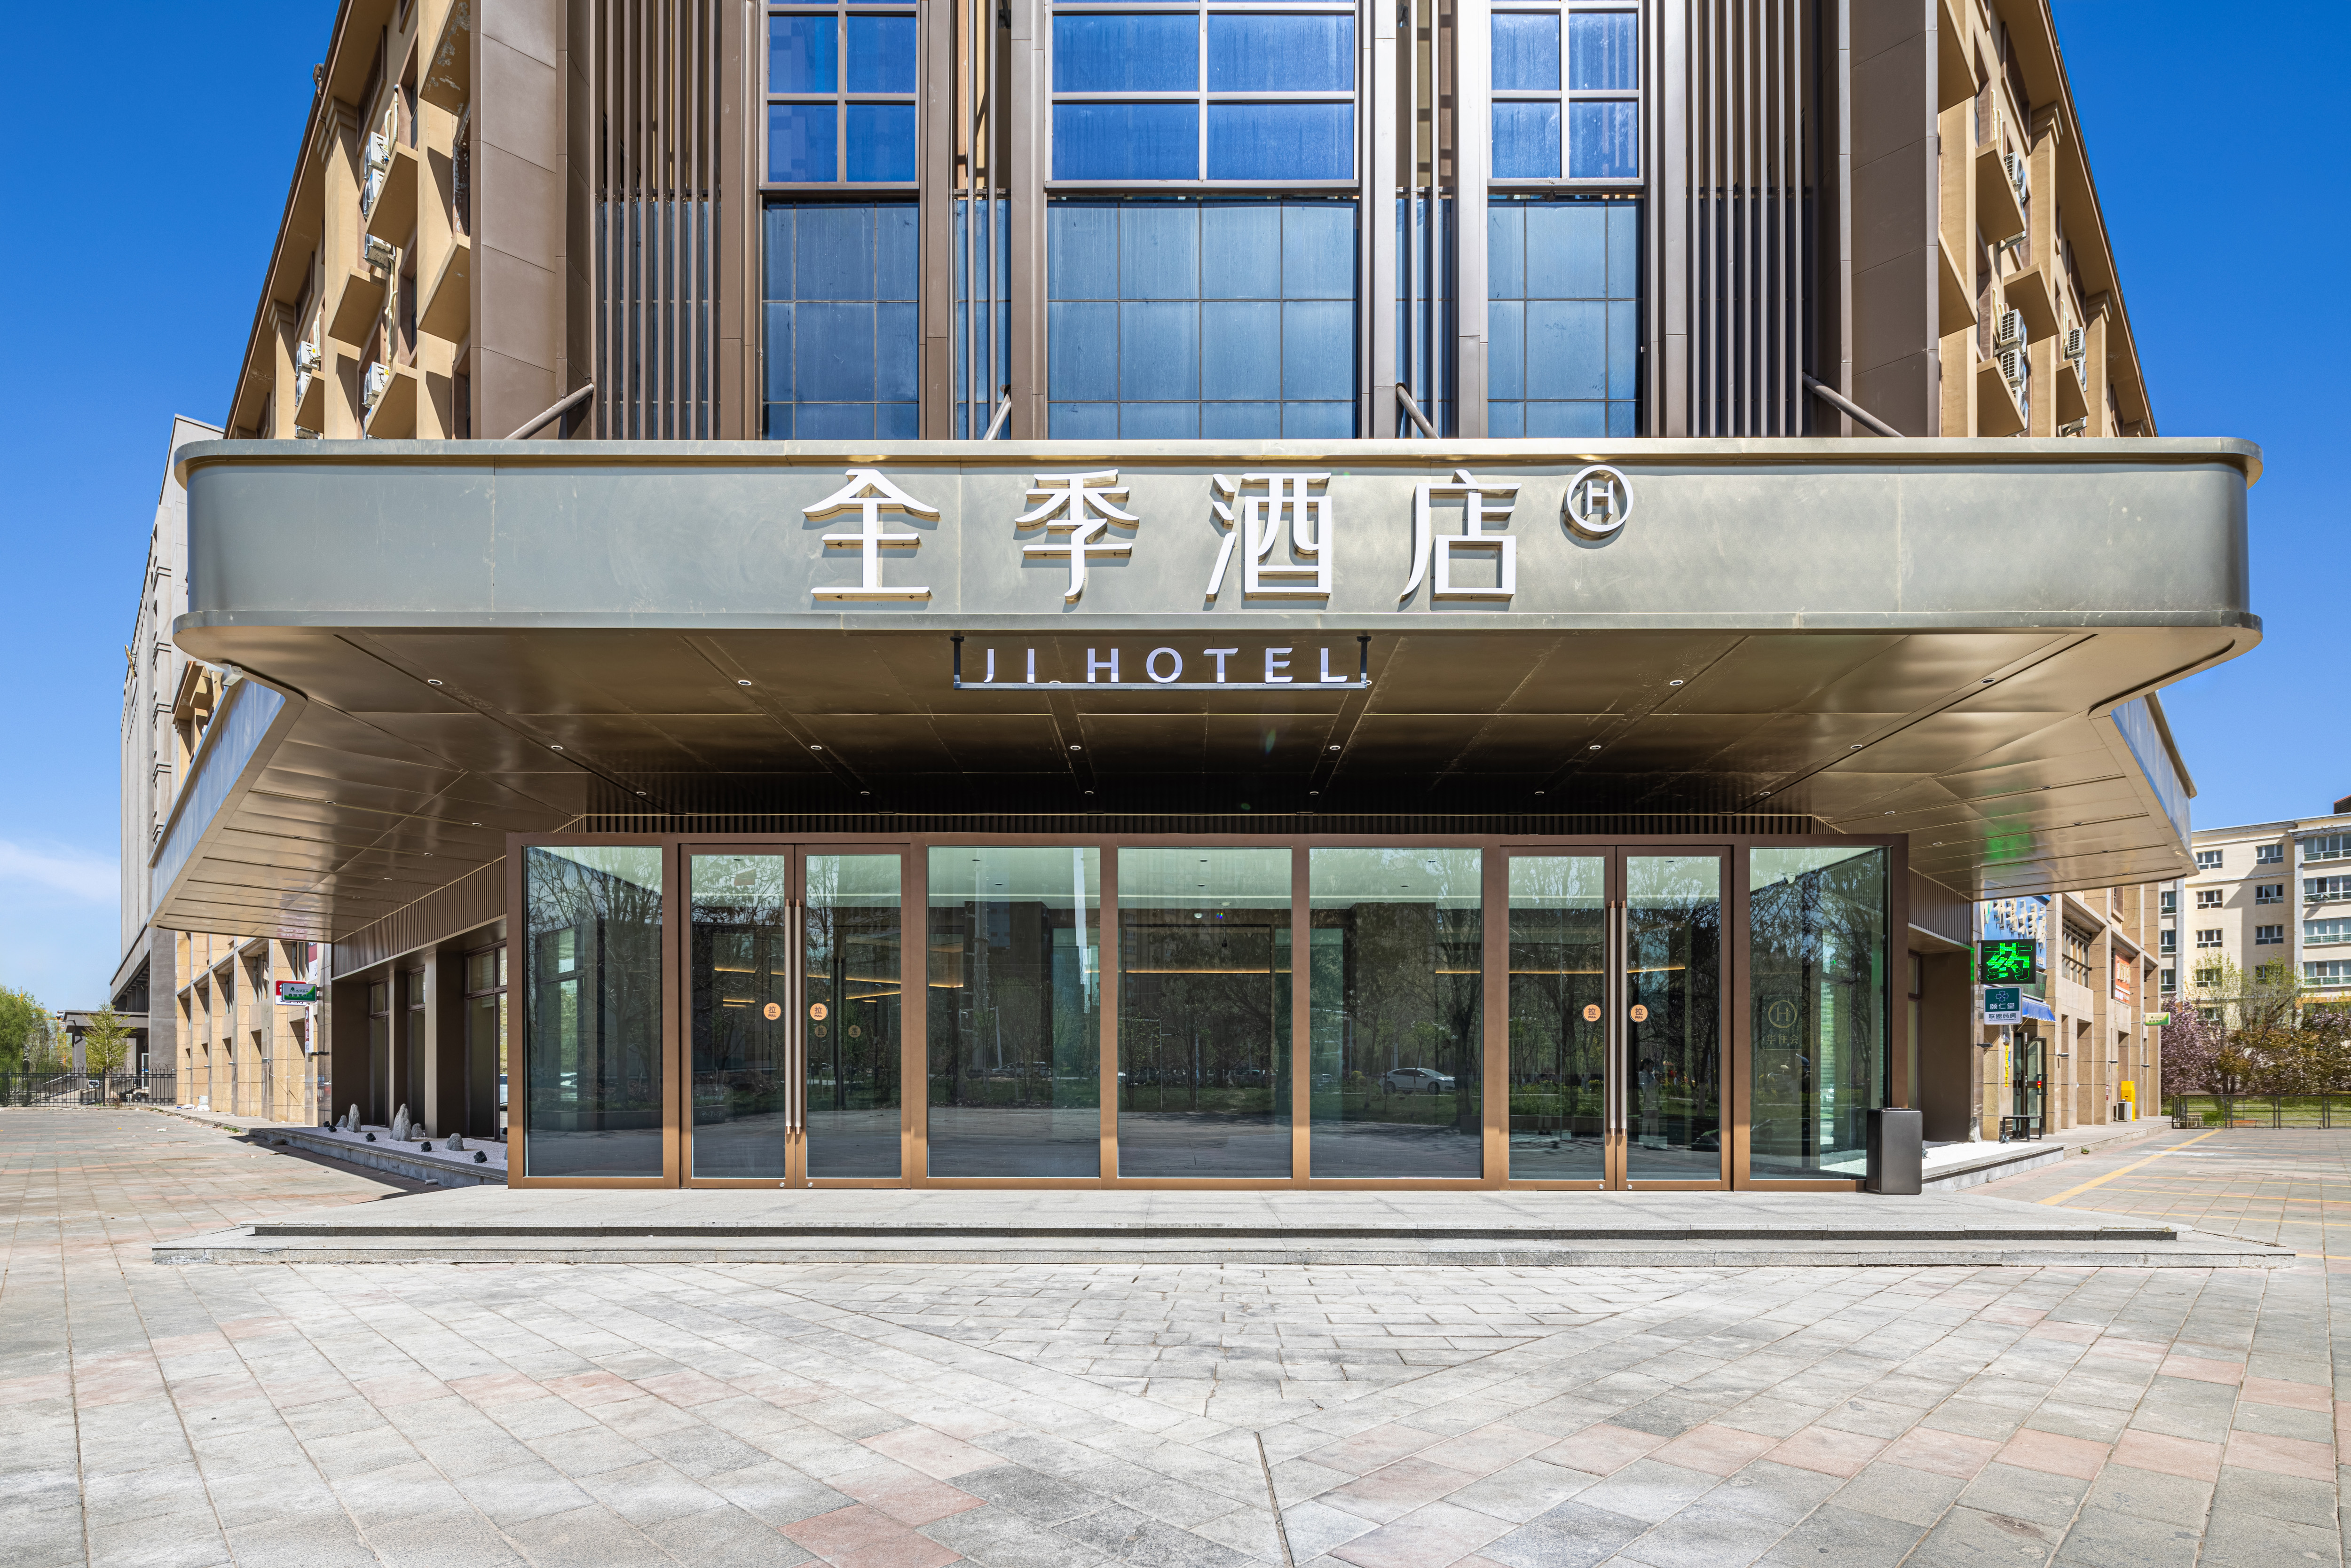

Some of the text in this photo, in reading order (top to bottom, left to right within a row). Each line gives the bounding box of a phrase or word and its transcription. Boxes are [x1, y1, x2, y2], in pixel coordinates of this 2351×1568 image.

[801, 468, 1523, 604] 全季酒店
[984, 647, 1348, 684] JI HOTEL
[1985, 942, 2032, 981] 药
[1766, 1034, 1799, 1044] 华住会
